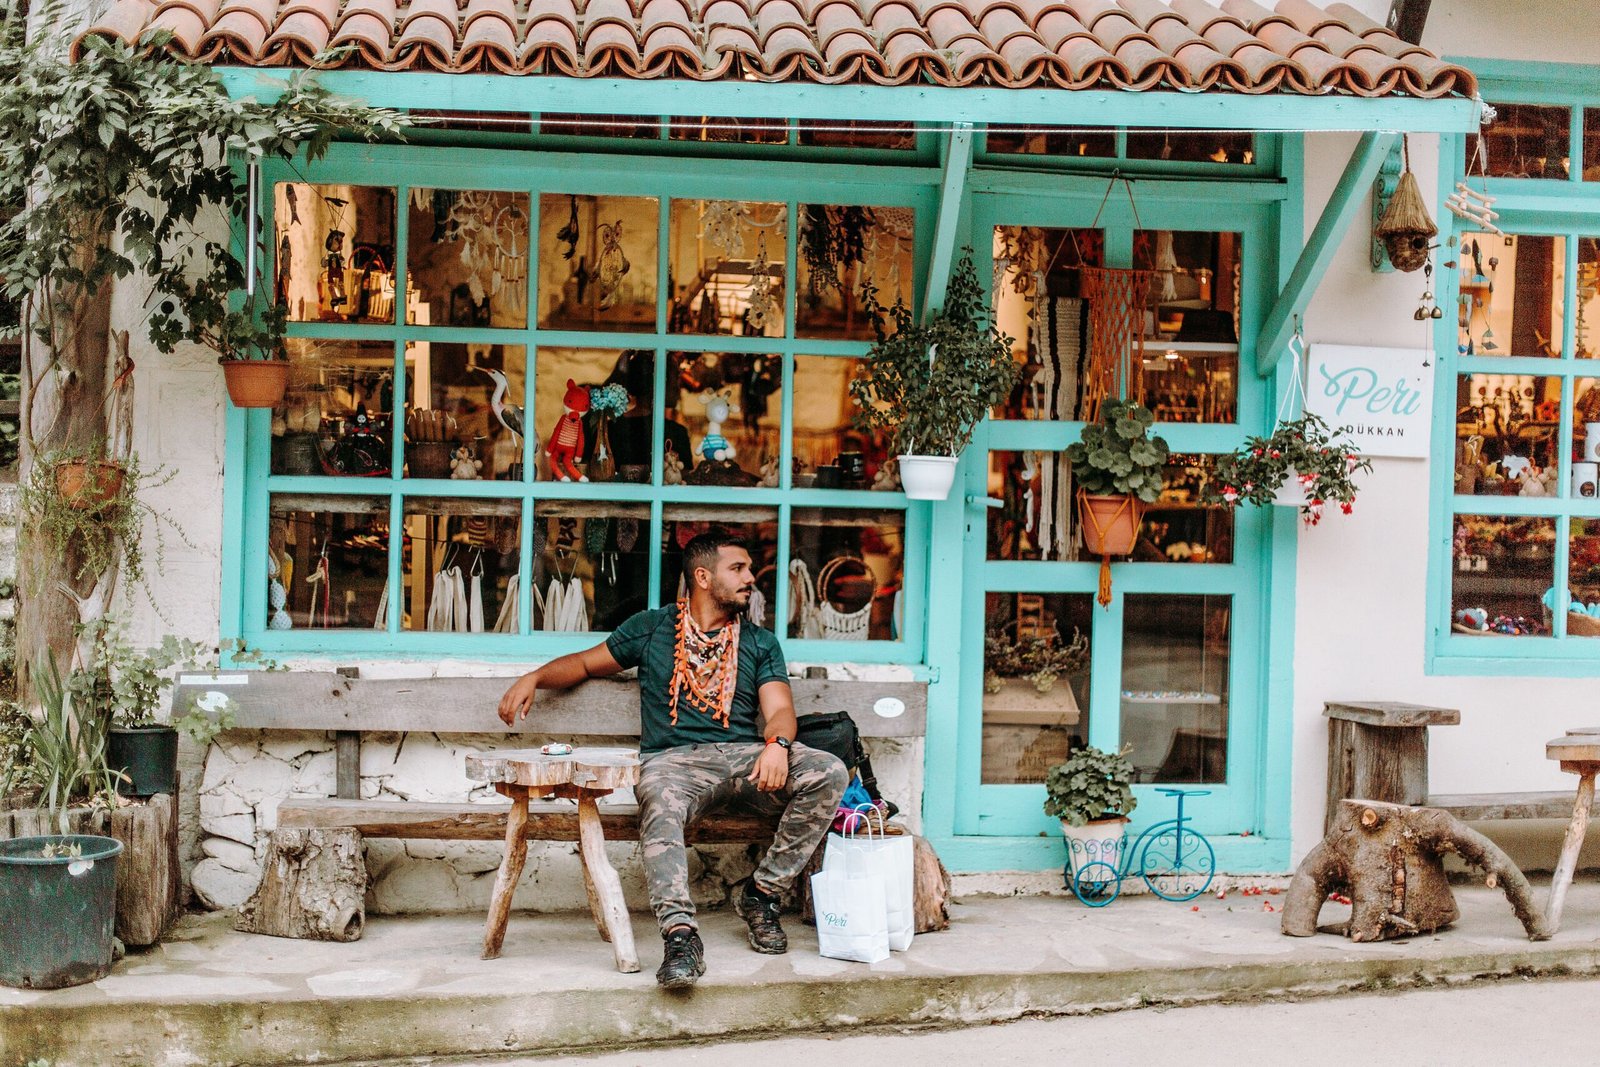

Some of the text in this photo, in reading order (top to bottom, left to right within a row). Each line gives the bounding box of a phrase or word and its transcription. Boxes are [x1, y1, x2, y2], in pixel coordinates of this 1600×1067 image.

[1319, 363, 1421, 416] Peri
[1345, 423, 1405, 438] DÜKKAN
[822, 911, 848, 927] Peri
